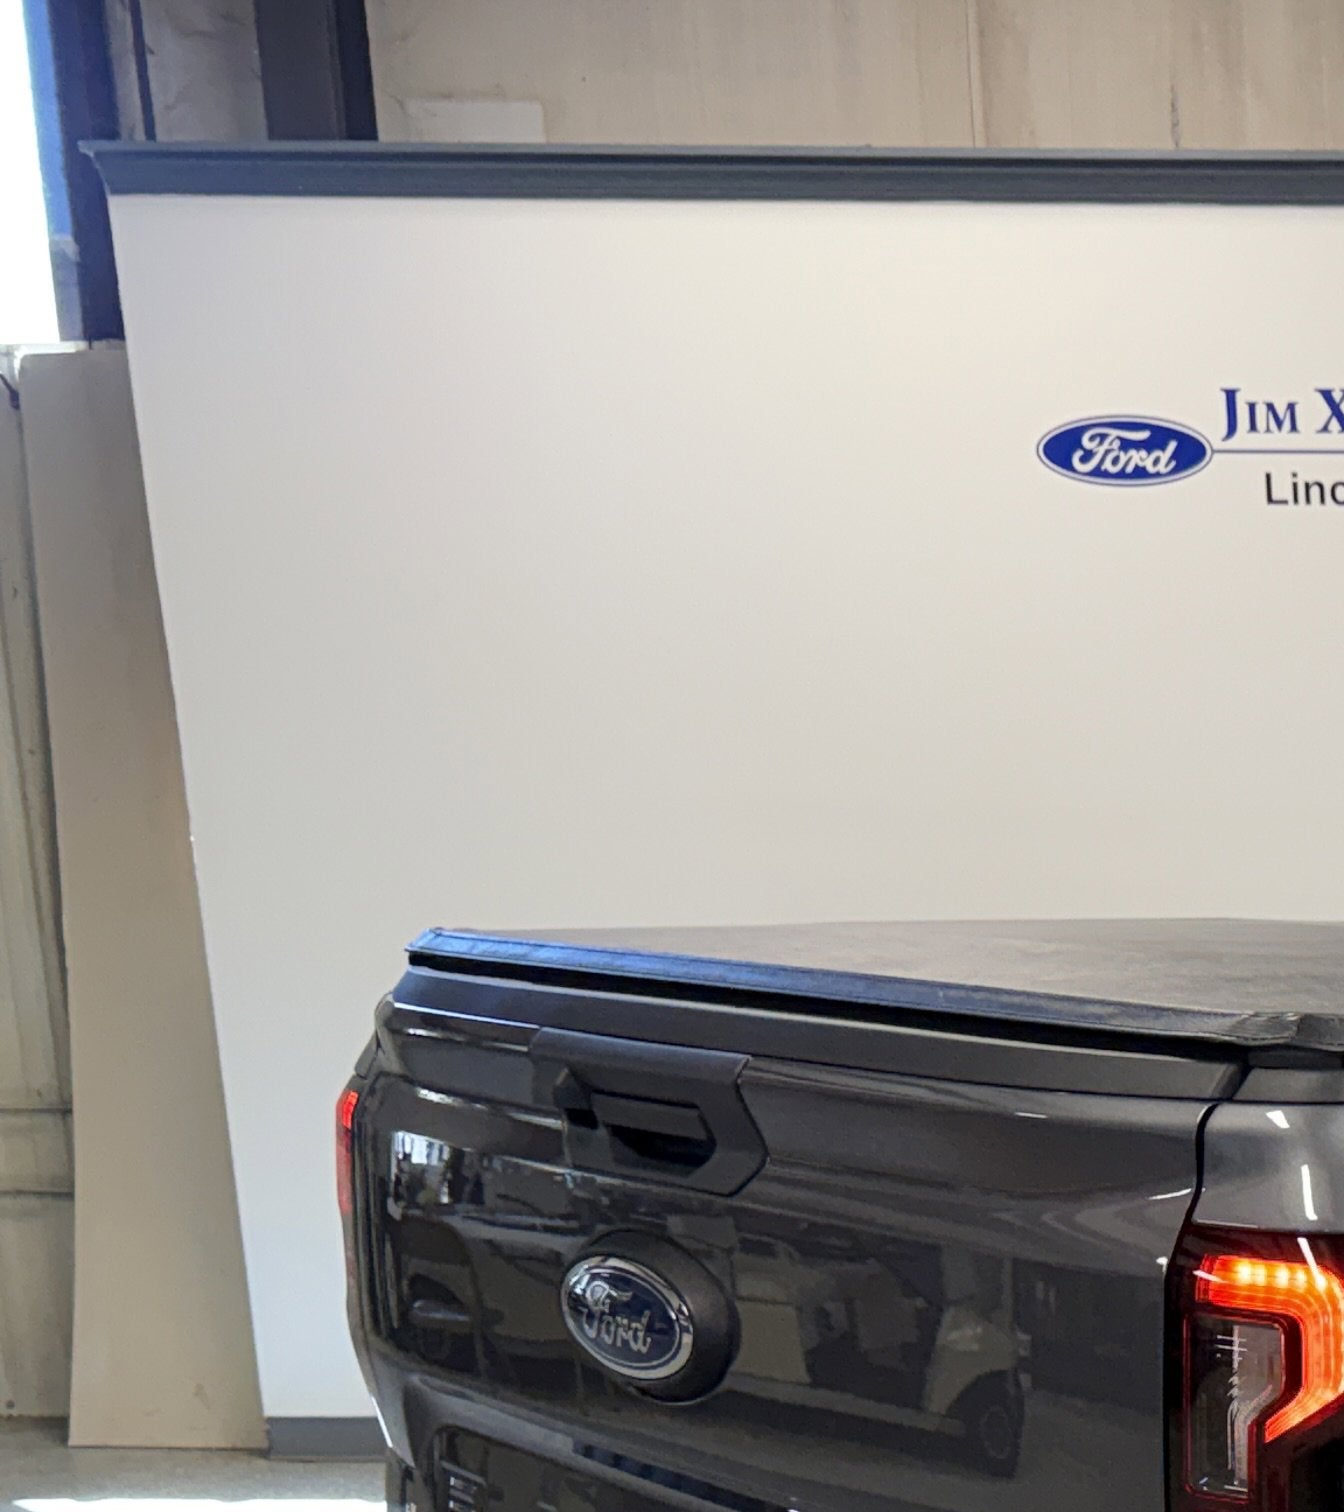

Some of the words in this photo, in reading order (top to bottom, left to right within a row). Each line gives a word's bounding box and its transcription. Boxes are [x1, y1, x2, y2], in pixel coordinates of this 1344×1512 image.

[1220, 388, 1300, 442] JIM
[1071, 426, 1176, 475] Ford
[579, 1281, 652, 1354] Ford
